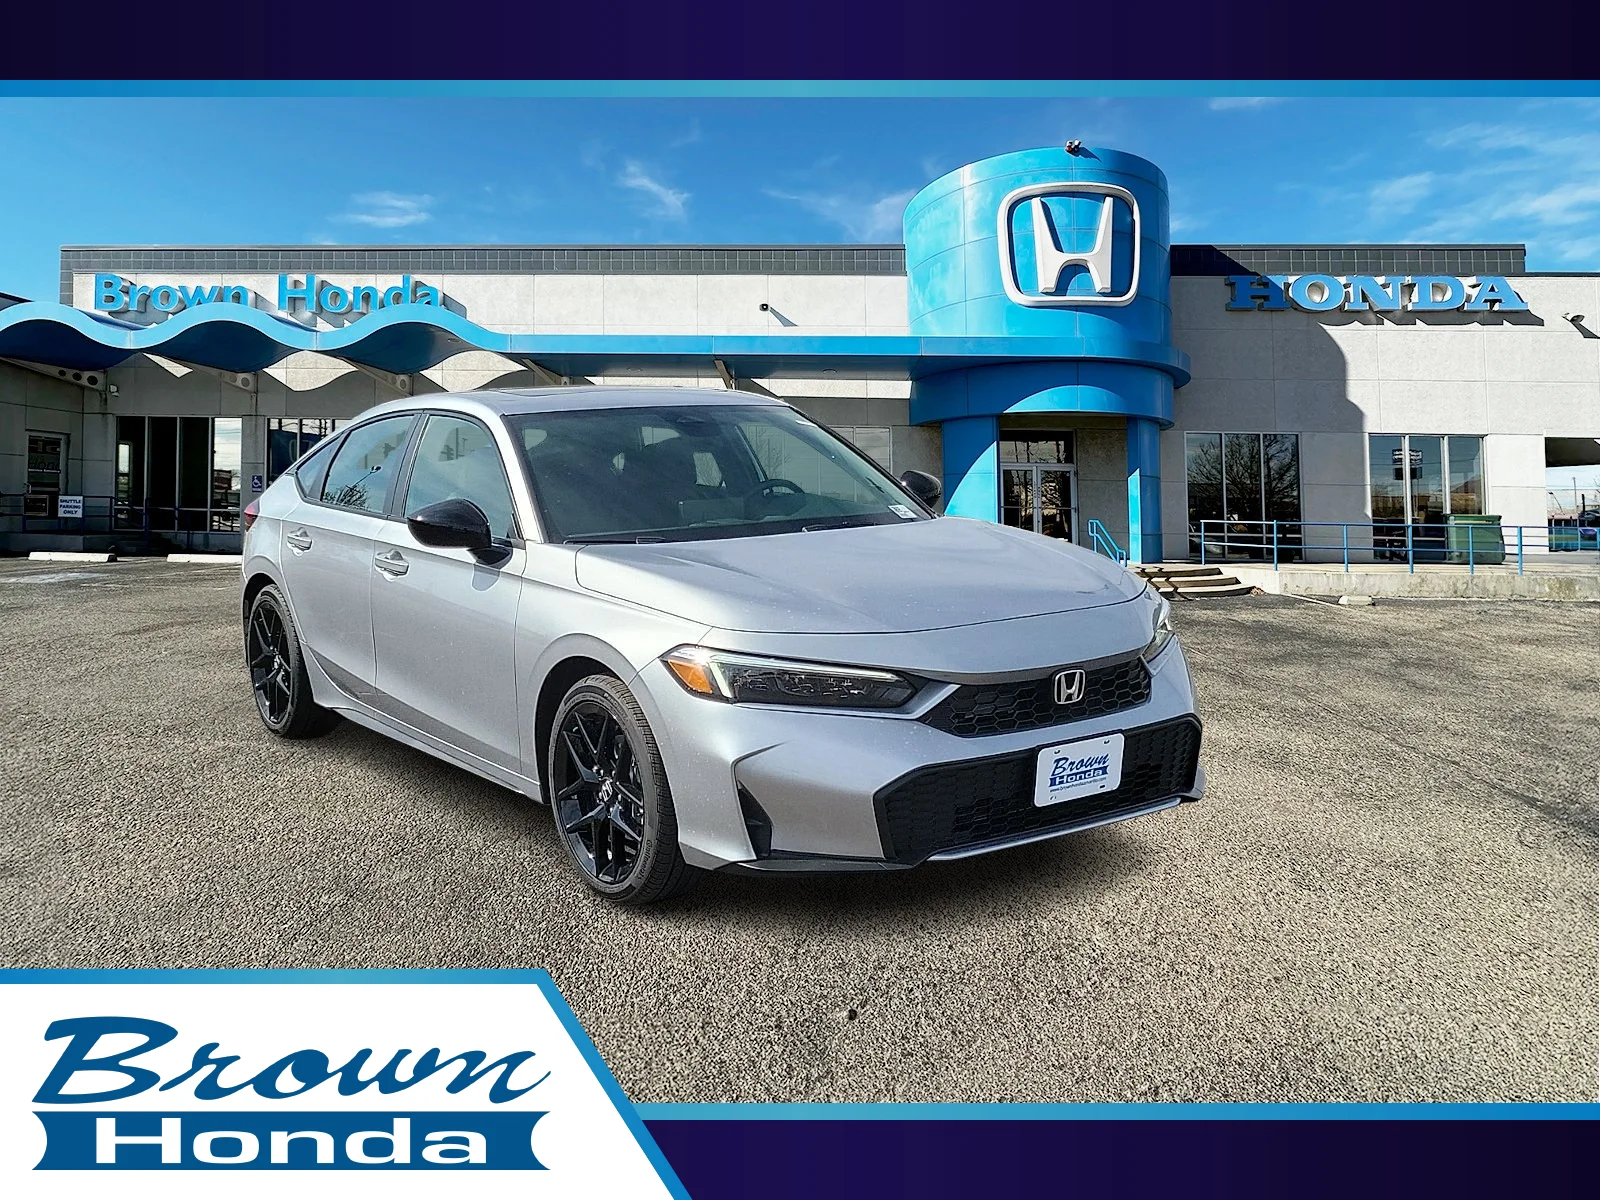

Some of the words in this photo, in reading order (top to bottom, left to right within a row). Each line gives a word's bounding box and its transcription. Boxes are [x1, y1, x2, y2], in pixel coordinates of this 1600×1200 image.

[94, 273, 249, 311] Brown
[278, 274, 440, 312] Honda
[1226, 274, 1528, 311] HONDA
[1051, 754, 1109, 776] Brown
[1055, 769, 1103, 785] Honda
